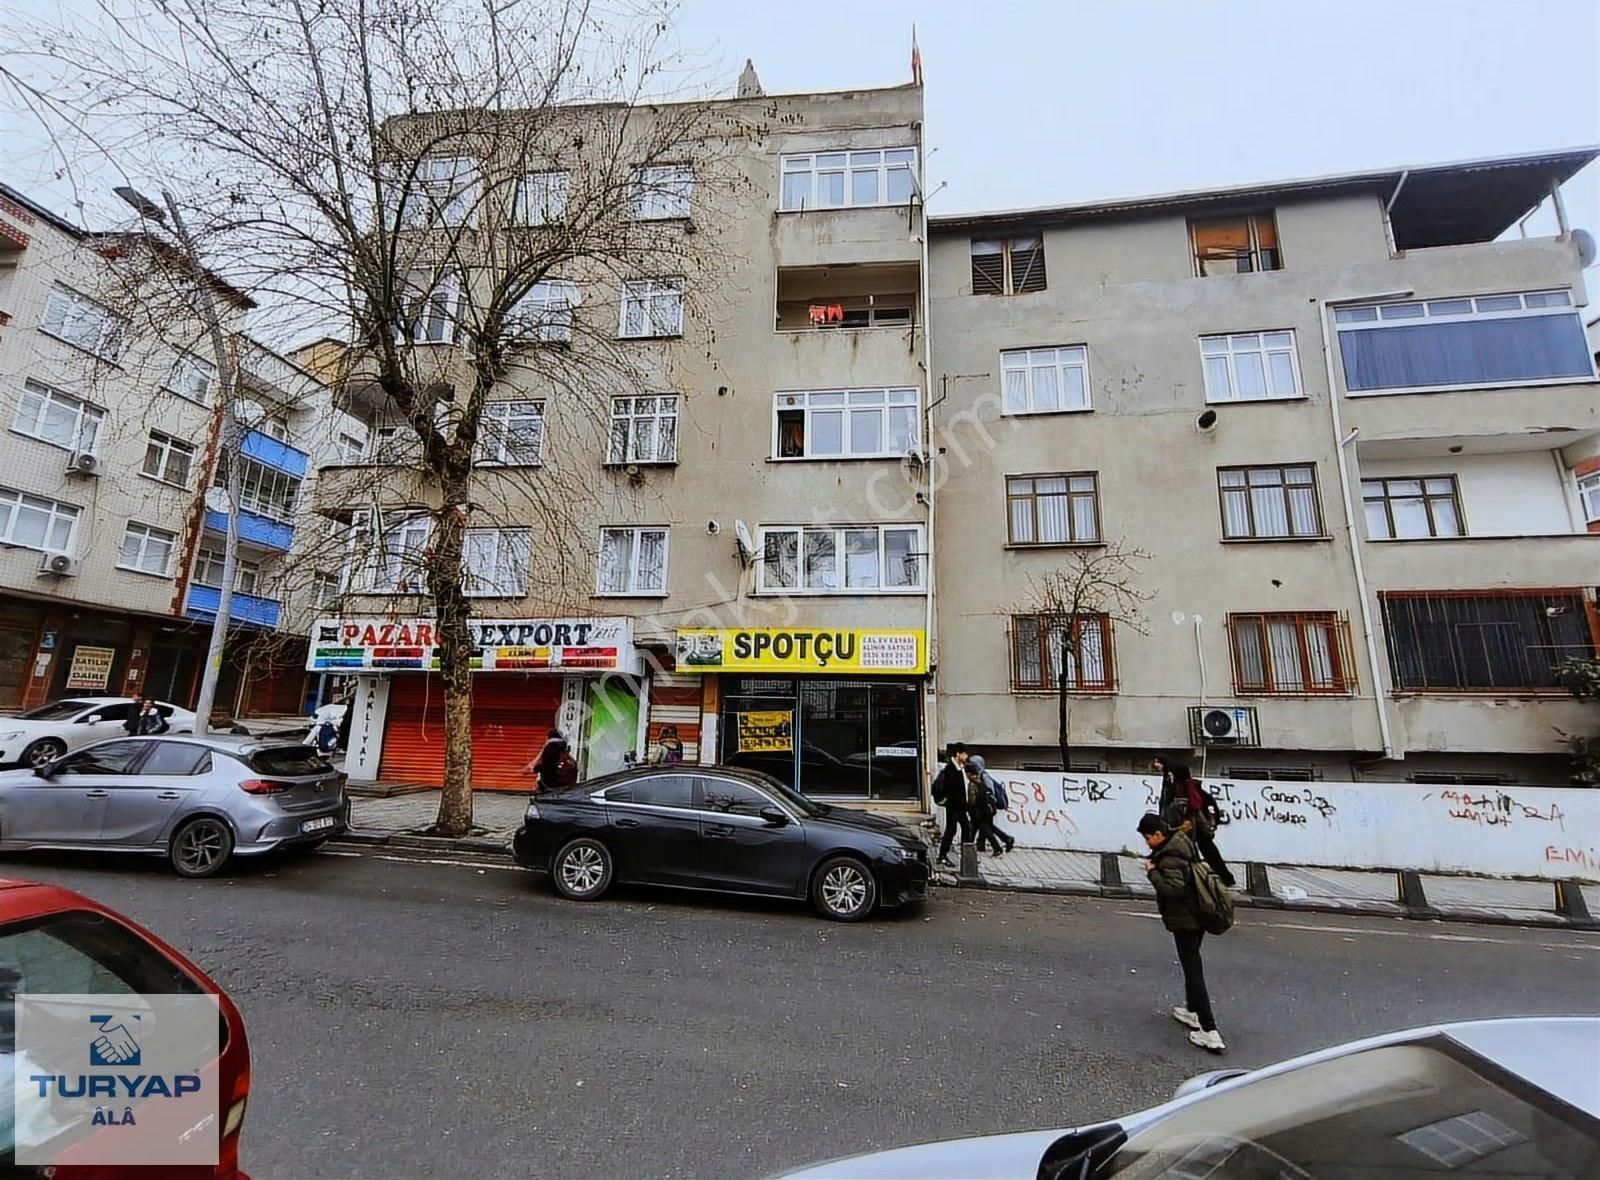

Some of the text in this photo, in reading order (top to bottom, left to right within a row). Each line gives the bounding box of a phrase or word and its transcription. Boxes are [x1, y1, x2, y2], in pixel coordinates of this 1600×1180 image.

[478, 623, 592, 646] EXPORT
[734, 633, 855, 666] SPOTÇU
[1009, 781, 1046, 803] 58
